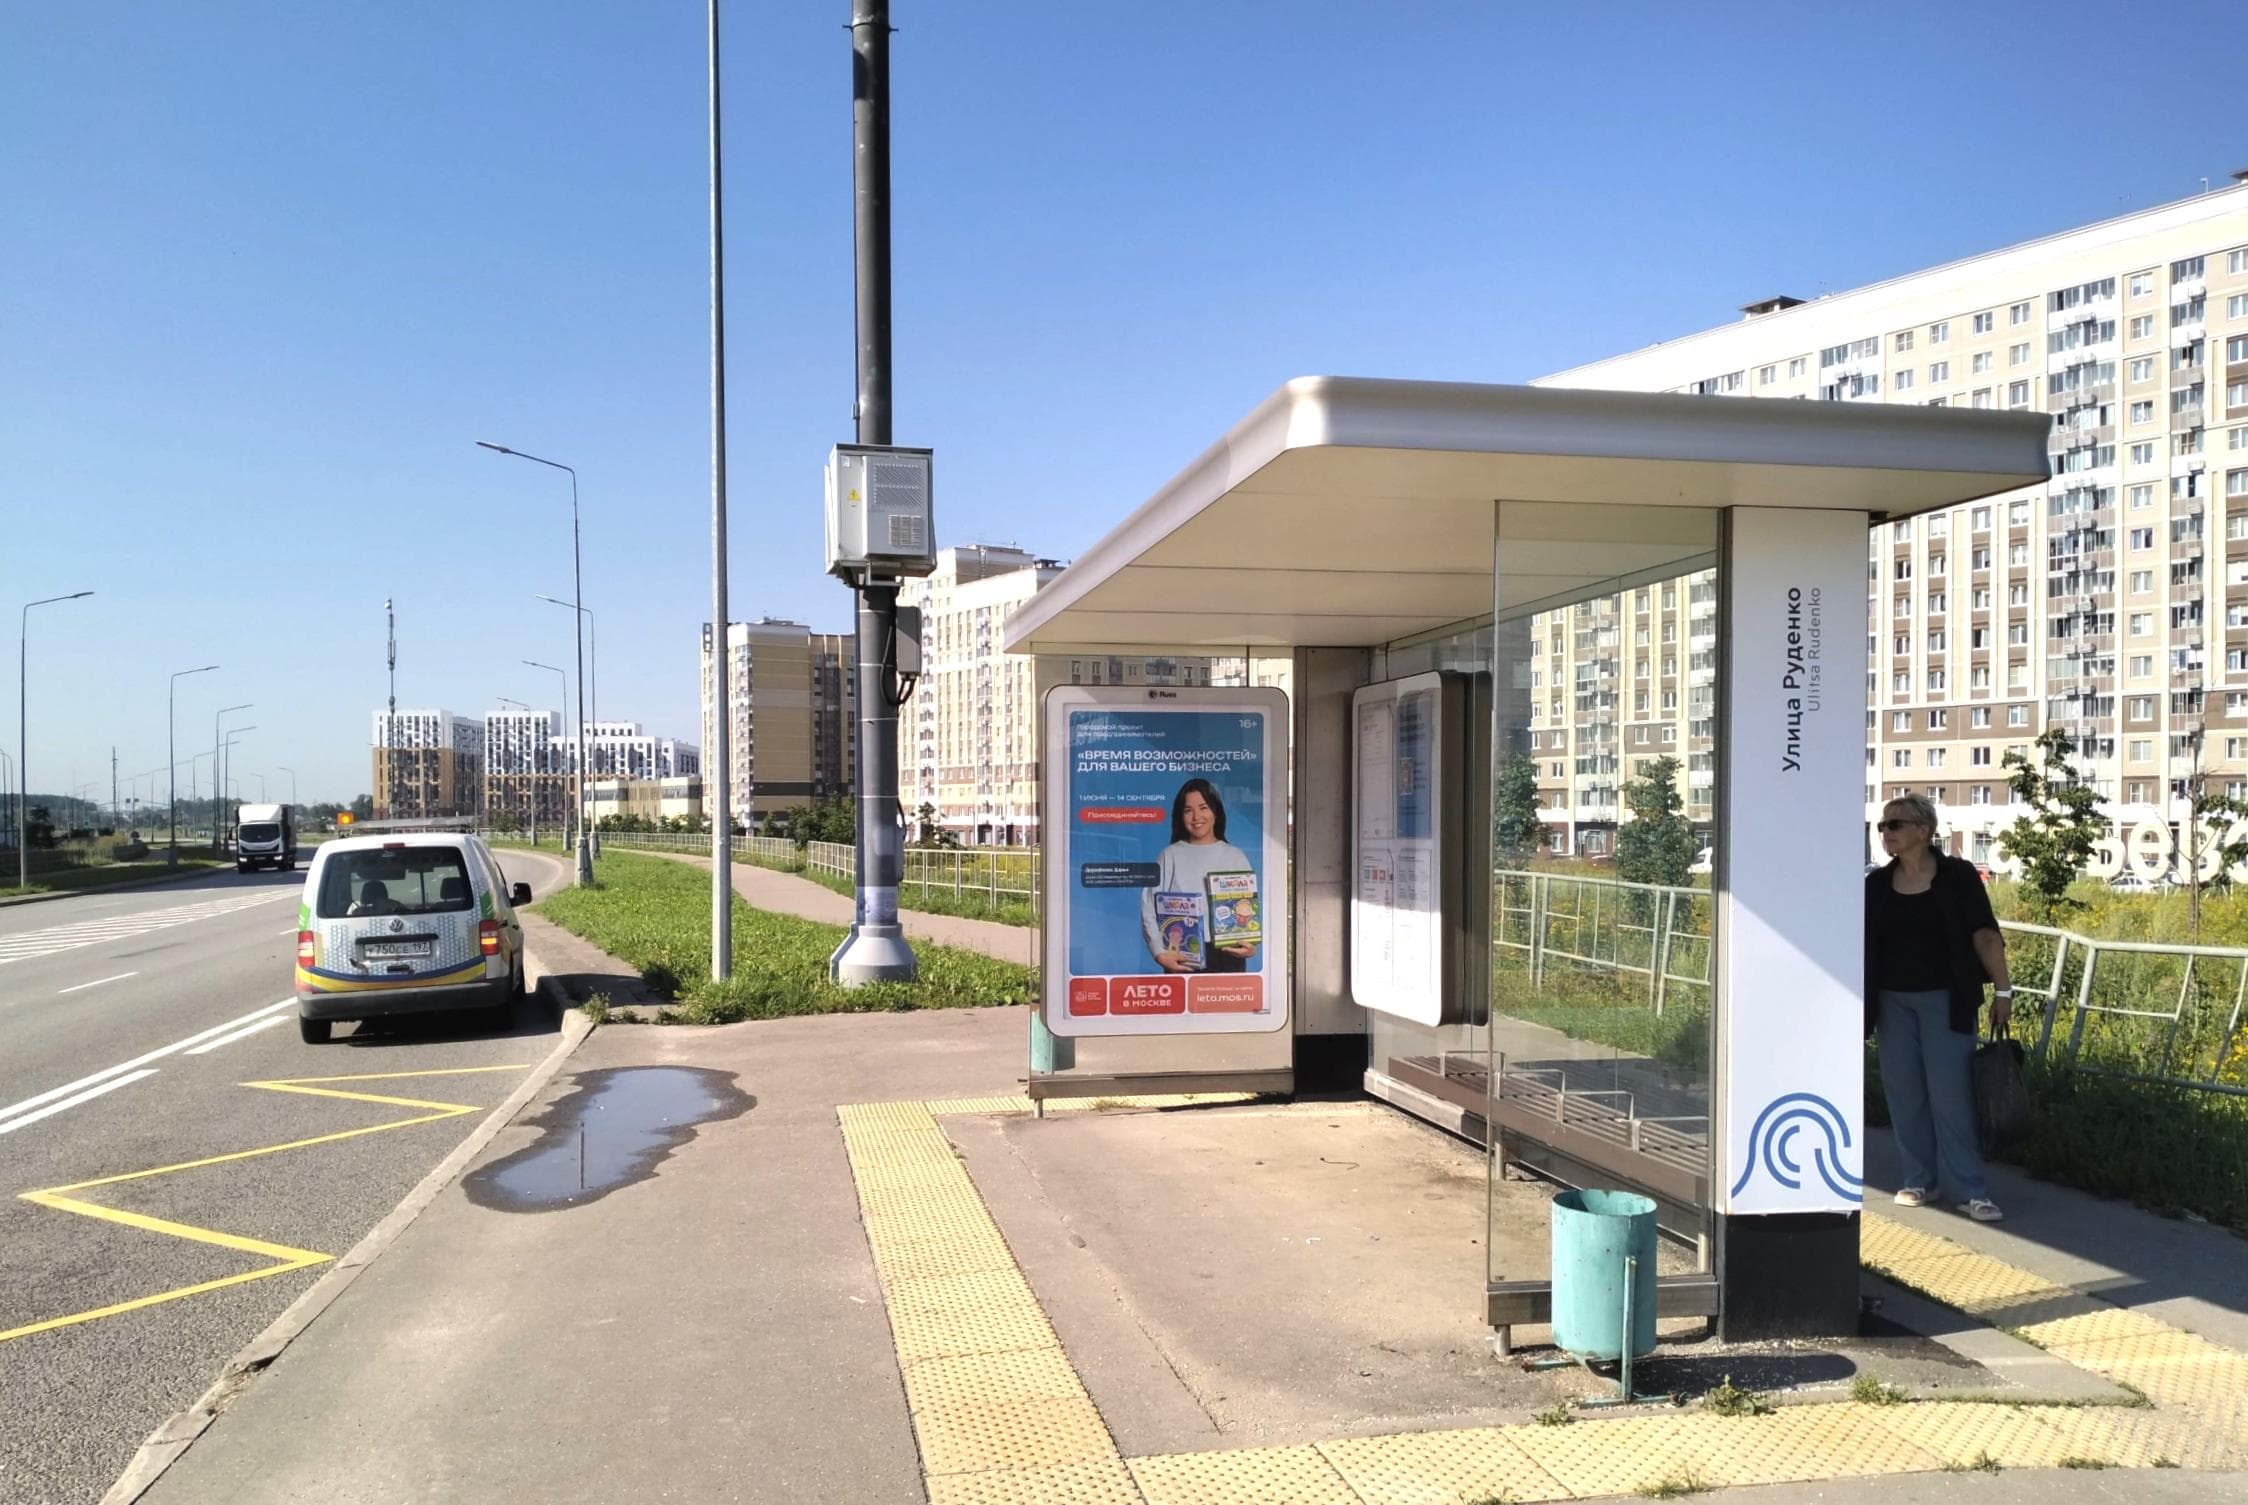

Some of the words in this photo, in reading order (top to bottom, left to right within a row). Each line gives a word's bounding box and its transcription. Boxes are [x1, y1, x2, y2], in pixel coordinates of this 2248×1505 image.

[1807, 587, 1821, 660] Rudenko
[1782, 587, 1805, 689] Руденко
[1807, 665, 1821, 711] Ulitsa
[1782, 698, 1804, 772] Улица
[1078, 751, 1131, 760] «ВРЕМЯ
[1134, 749, 1257, 761] ВОЗМОЖНОСТЕЙ»
[1077, 762, 1107, 772] ДЛЯ
[1110, 762, 1166, 771] ВАШЕГО
[1169, 762, 1231, 771] БИЗНЕСА
[1123, 984, 1172, 998] ЛЕТО
[1197, 993, 1254, 1002] leto.mos.ru
[1132, 999, 1172, 1007] МОСКВЕ
